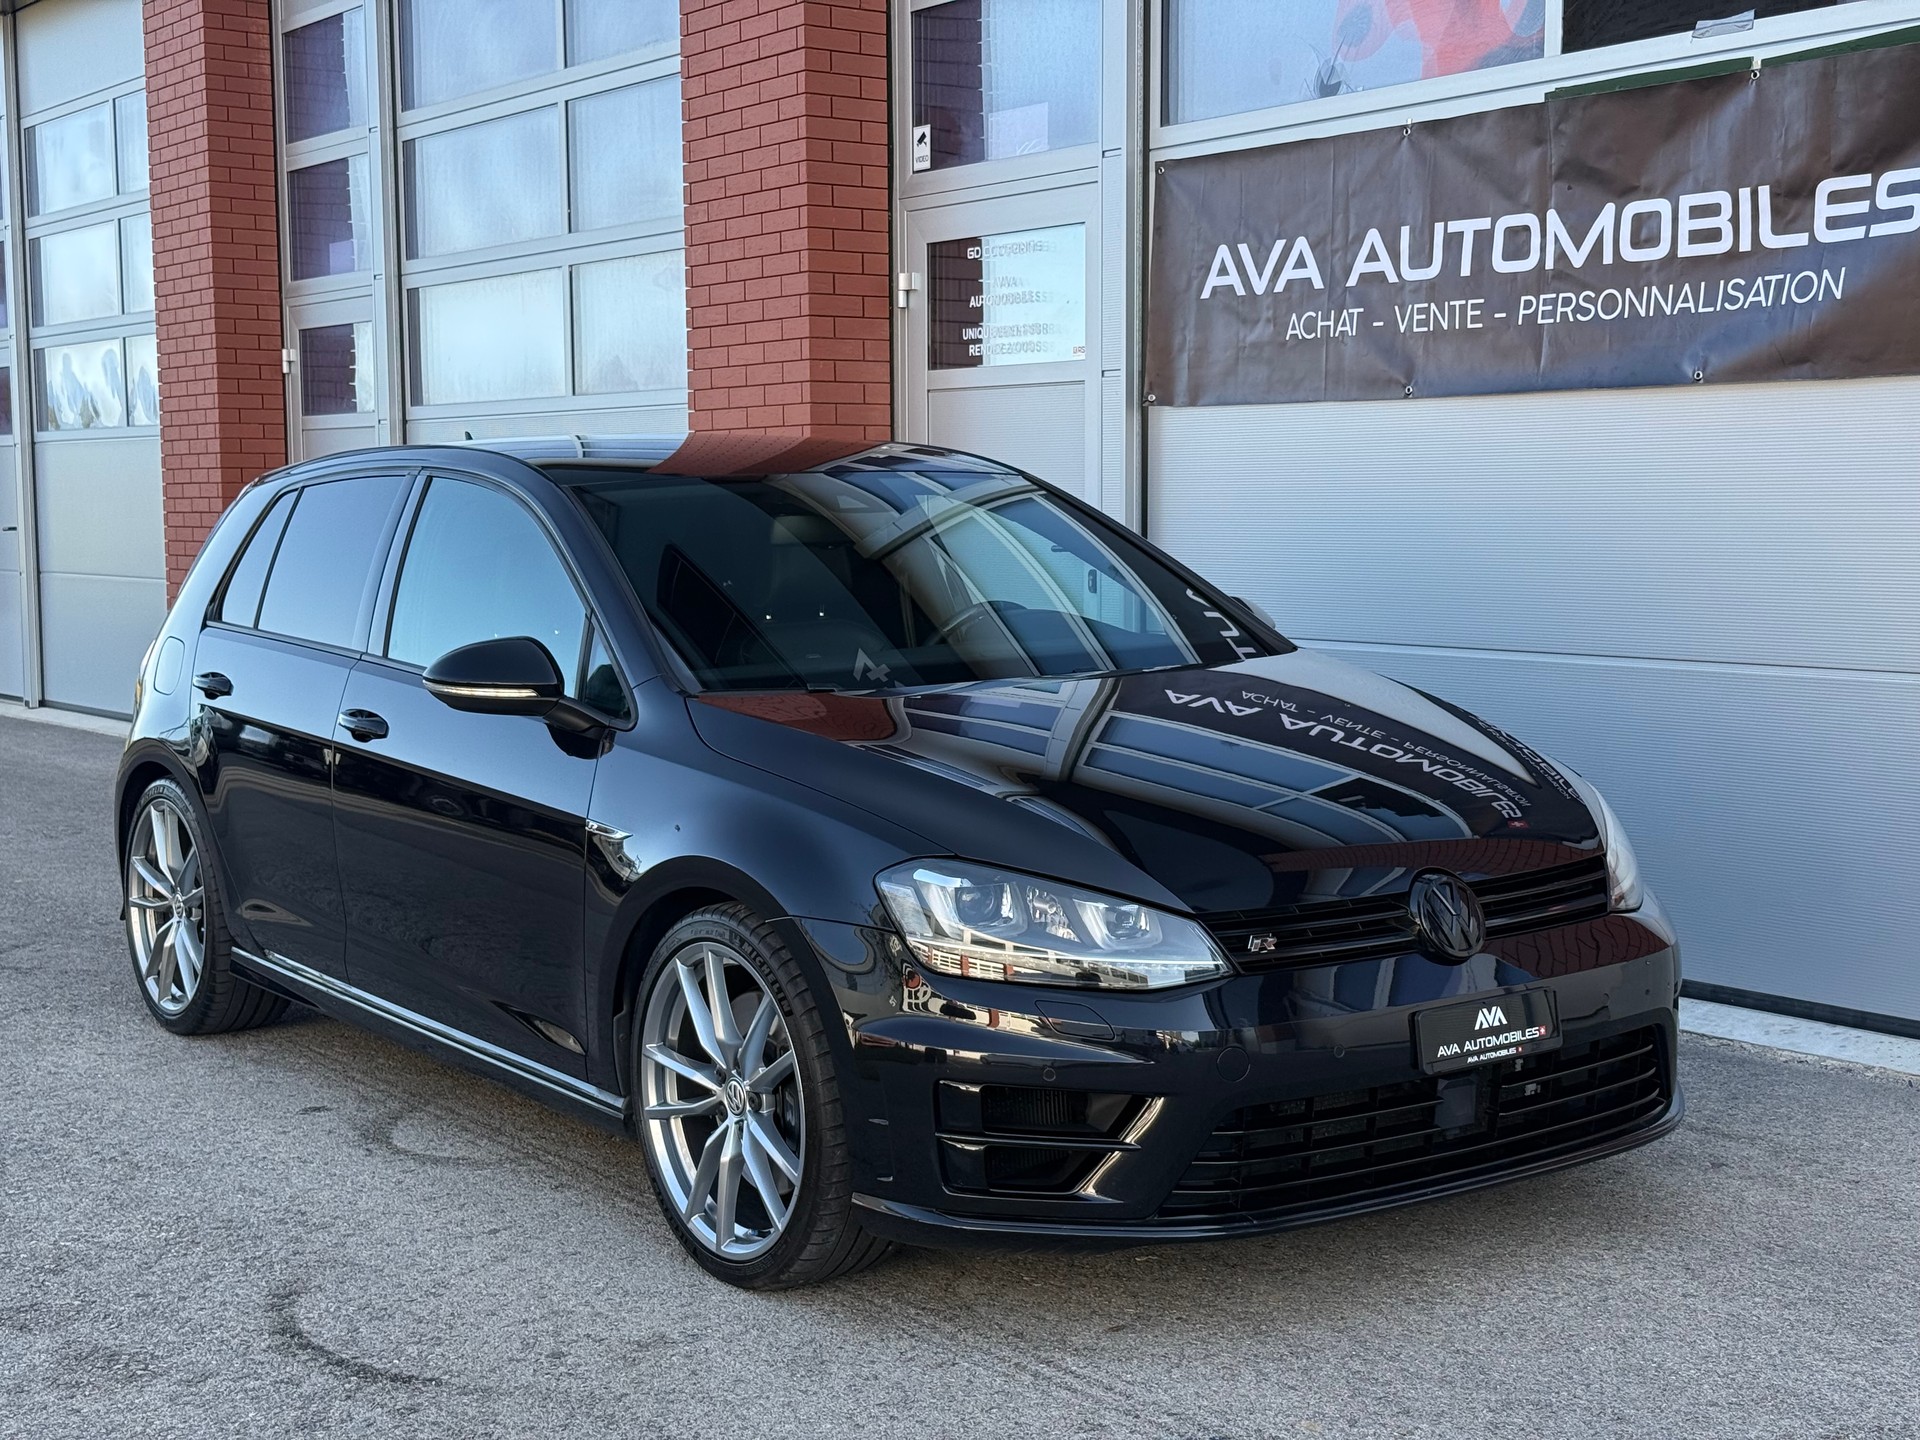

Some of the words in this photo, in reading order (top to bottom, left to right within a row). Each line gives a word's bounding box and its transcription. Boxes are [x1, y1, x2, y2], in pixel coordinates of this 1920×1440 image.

[915, 155, 929, 163] VIDEO
[1200, 236, 1324, 299] AVA
[1345, 167, 1920, 287] AUTOMOBILES
[1286, 308, 1364, 340] ACHAT
[1394, 299, 1485, 333] VENTE
[1517, 267, 1846, 326] PERSONNALISATION
[742, 942, 793, 1017] MICHELIN
[1474, 1006, 1508, 1030] AVA
[1437, 1044, 1461, 1058] AVA
[1464, 1026, 1540, 1052] AUTOMOBILES
[1467, 1055, 1479, 1063] AVA
[1480, 1047, 1517, 1061] AUTOMOBILES
